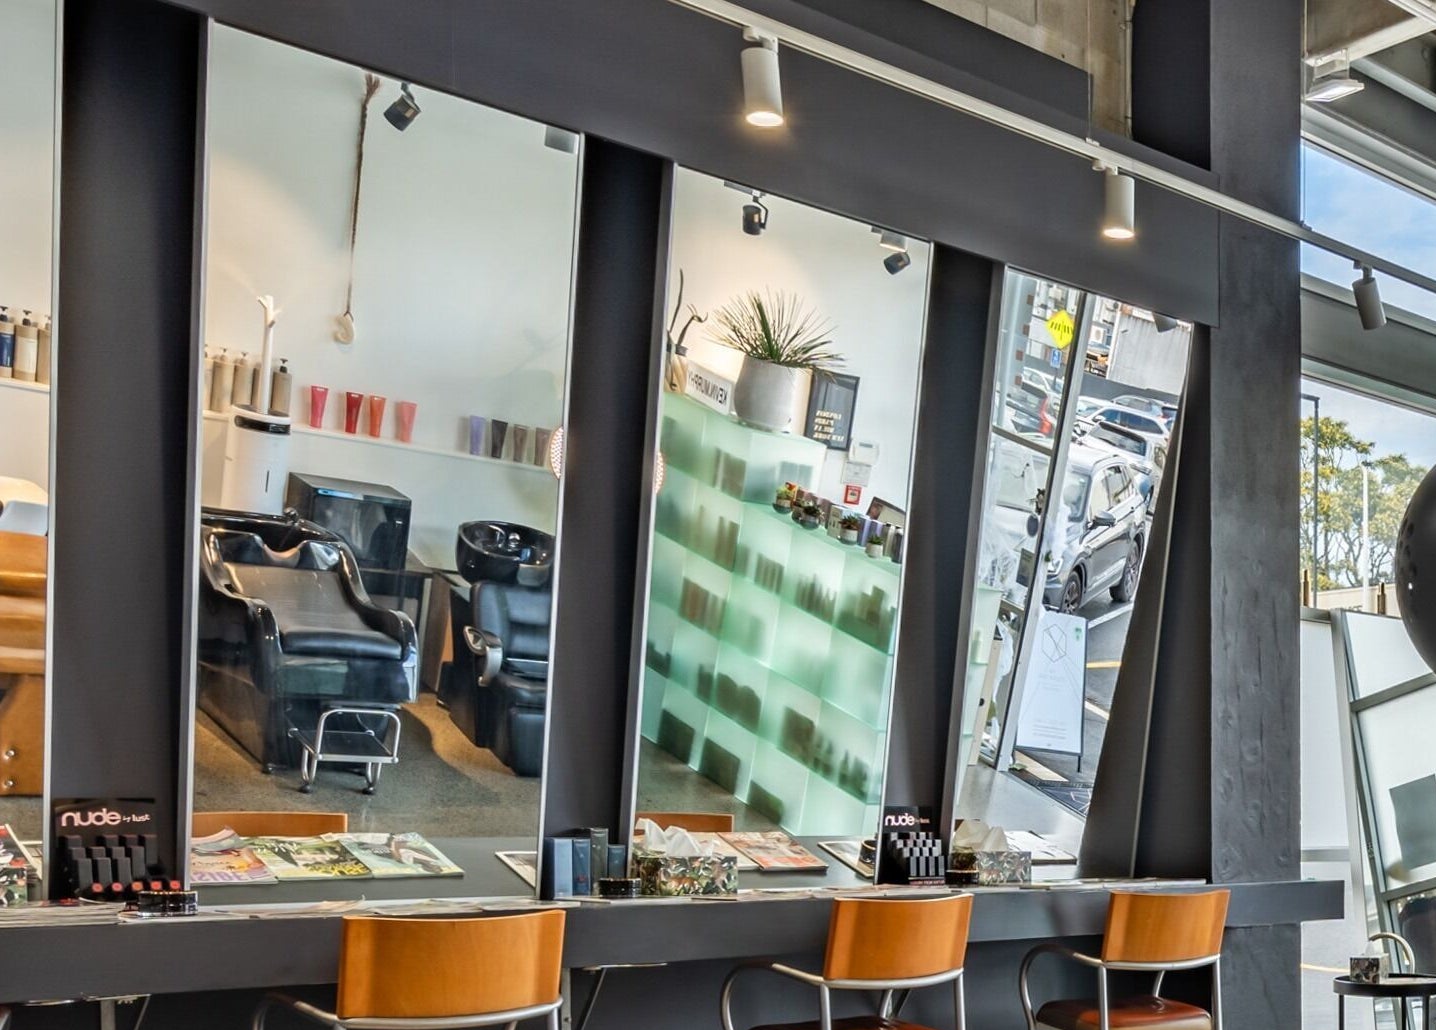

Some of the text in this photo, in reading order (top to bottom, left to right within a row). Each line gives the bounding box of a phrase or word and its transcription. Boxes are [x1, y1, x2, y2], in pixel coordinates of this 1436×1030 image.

[61, 807, 121, 827] nude
[132, 813, 151, 822] lust
[884, 812, 915, 826] nude
